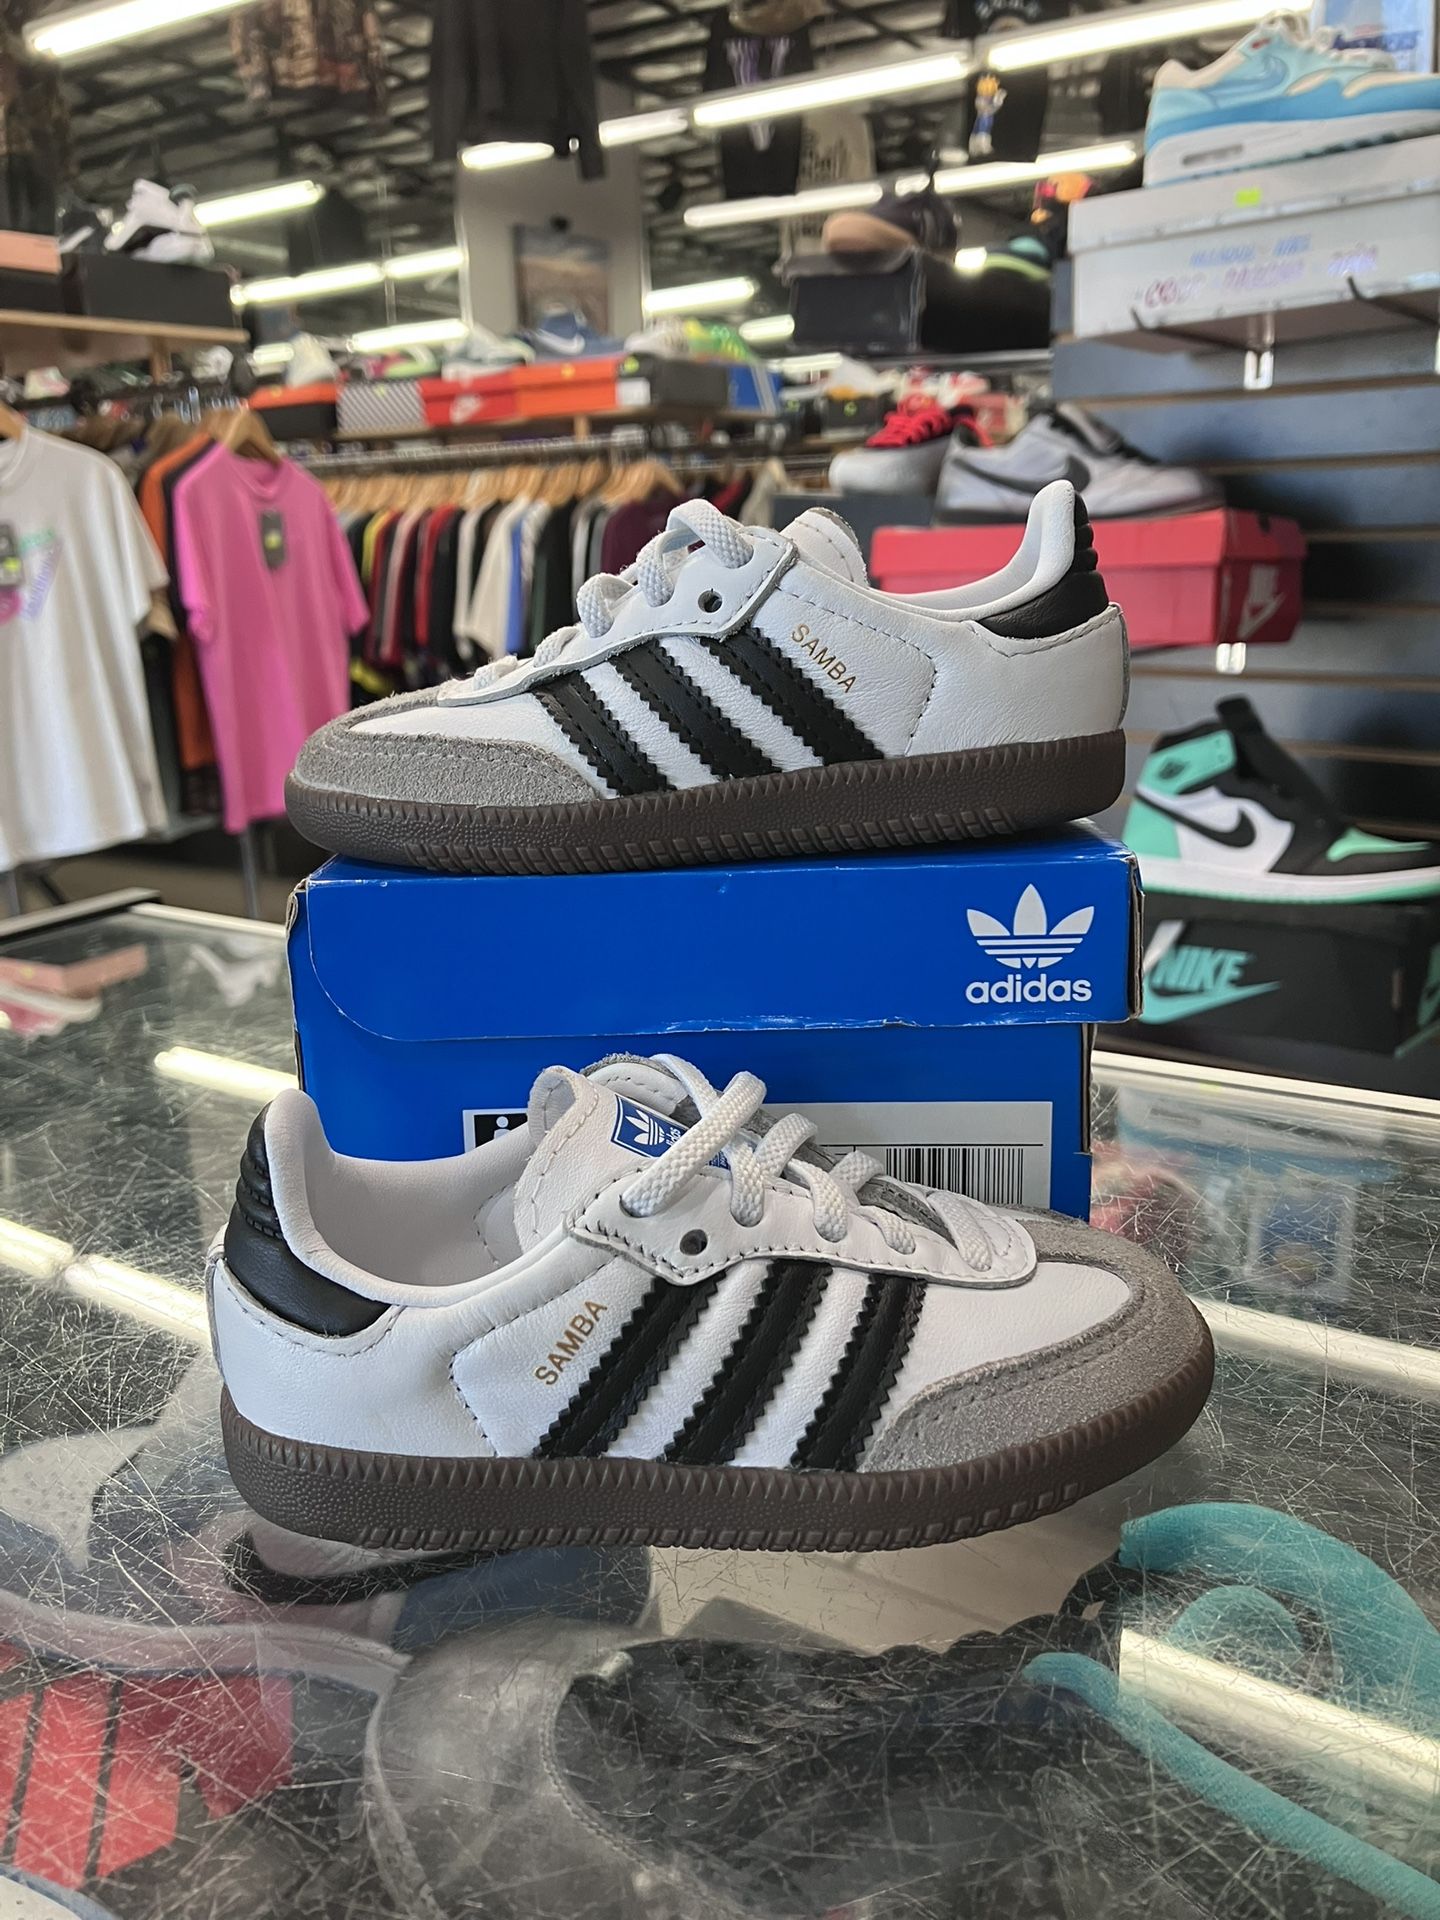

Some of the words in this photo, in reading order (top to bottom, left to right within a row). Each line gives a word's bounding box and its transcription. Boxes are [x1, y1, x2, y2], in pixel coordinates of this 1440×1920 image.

[791, 624, 856, 693] SAMBA
[966, 974, 1092, 1004] adidas
[1151, 945, 1248, 990] NIKE
[535, 1301, 607, 1385] SAMBA
